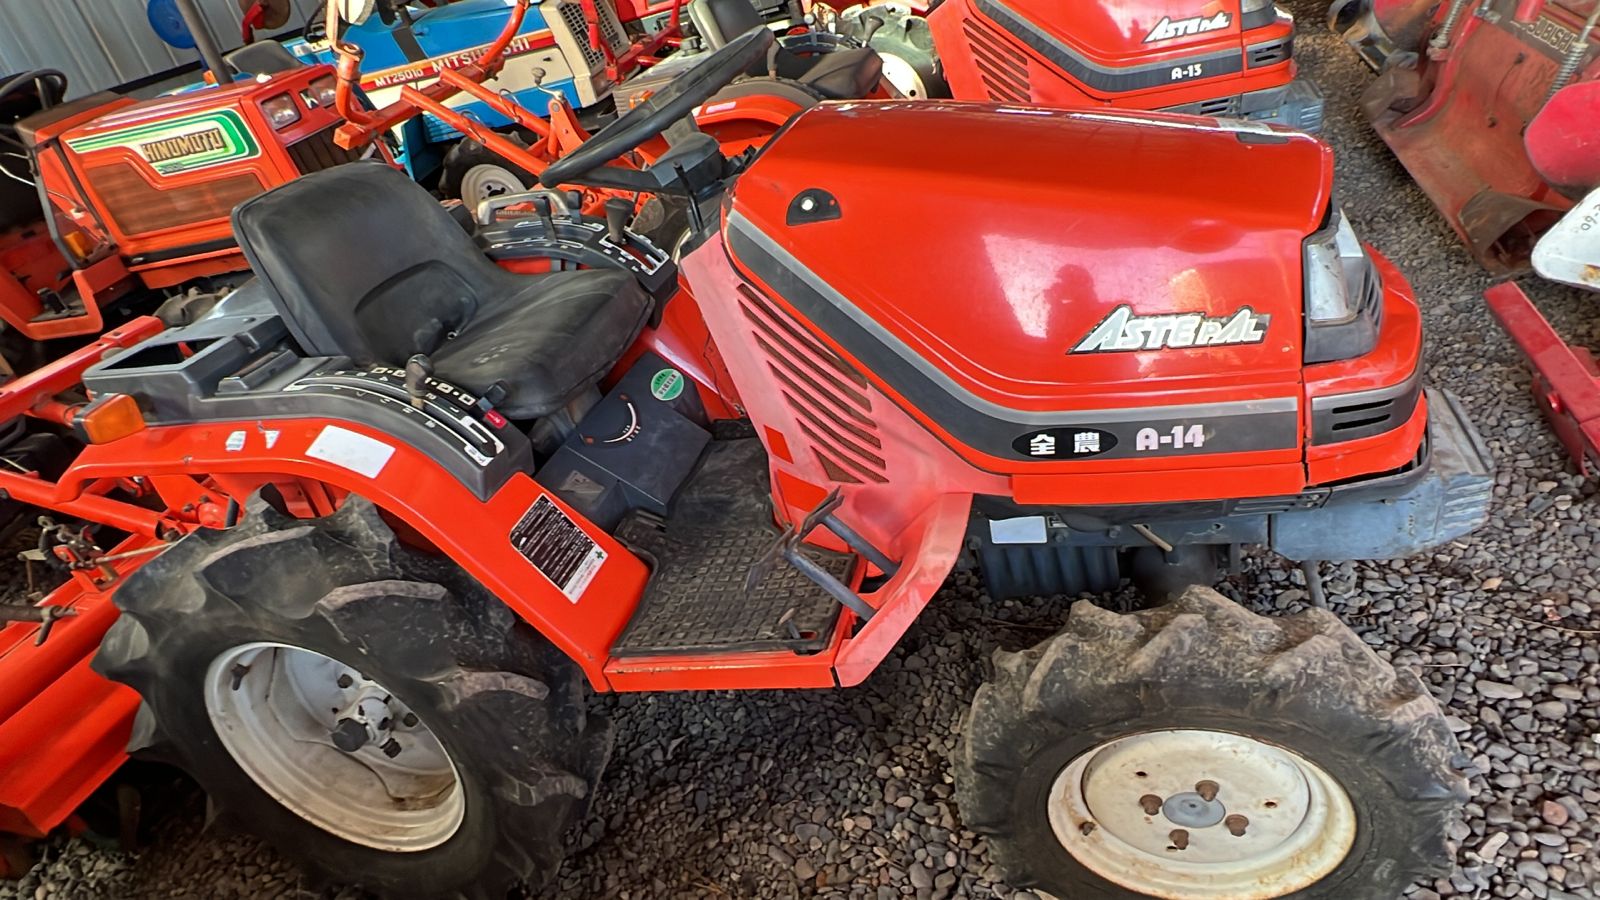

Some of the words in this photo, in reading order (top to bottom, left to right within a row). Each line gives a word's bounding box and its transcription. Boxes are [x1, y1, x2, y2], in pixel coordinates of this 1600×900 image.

[1171, 63, 1202, 80] A-13
[141, 128, 226, 163] HINOMOTO
[1072, 305, 1265, 352] ASTEPAL
[1030, 432, 1100, 455] 全農
[1136, 424, 1205, 451] A-14
